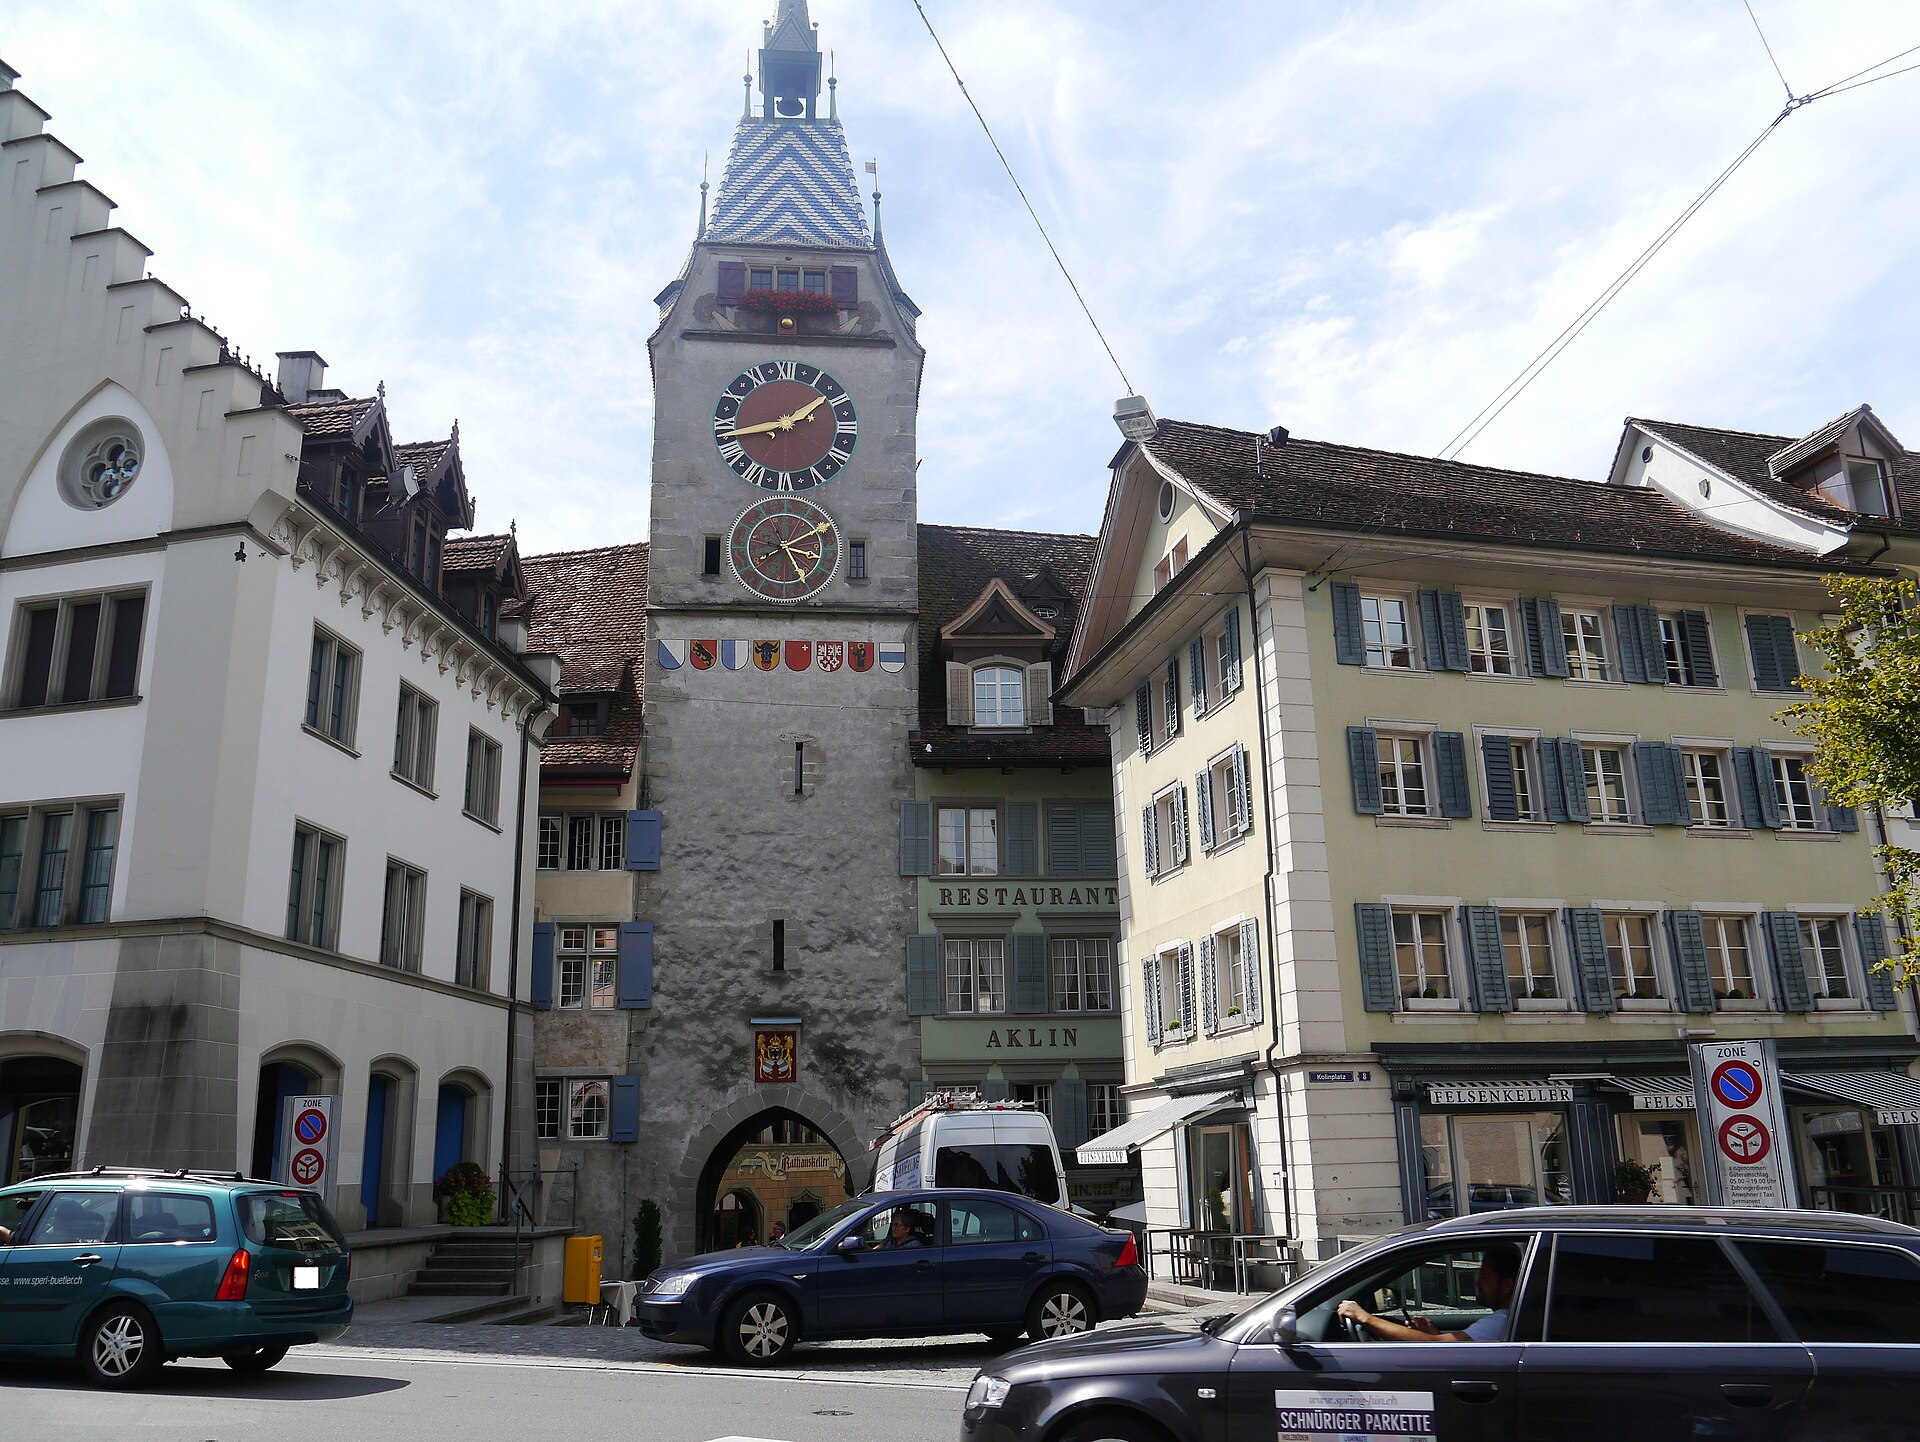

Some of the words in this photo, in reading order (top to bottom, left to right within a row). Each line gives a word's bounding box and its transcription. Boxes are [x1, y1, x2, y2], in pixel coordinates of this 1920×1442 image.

[743, 365, 767, 388] XI
[775, 361, 797, 380] XII
[811, 370, 824, 388] I
[721, 387, 746, 404] X
[829, 392, 851, 407] II
[714, 416, 736, 430] IX
[837, 420, 858, 435] III
[718, 440, 745, 467] VIII
[828, 446, 852, 468] IV
[741, 461, 766, 487] VII
[777, 472, 795, 491] VI
[810, 466, 827, 487] V
[939, 887, 1117, 906] RESTAURANT
[986, 1028, 1078, 1048] AKLIN
[1717, 1046, 1747, 1058] ZONE
[1316, 1072, 1347, 1081] Kolinplatz
[1362, 1072, 1367, 1080] 8
[303, 1099, 322, 1107] ZONE
[1434, 1089, 1571, 1104] FELSENKELLER
[1643, 1095, 1694, 1109] FELSE
[1881, 1110, 1919, 1124] FELS
[1730, 1184, 1773, 1192] Zubringerdienst
[1280, 1409, 1362, 1431] SCHNÜRIGER
[1365, 1412, 1432, 1432] PARKETTE
